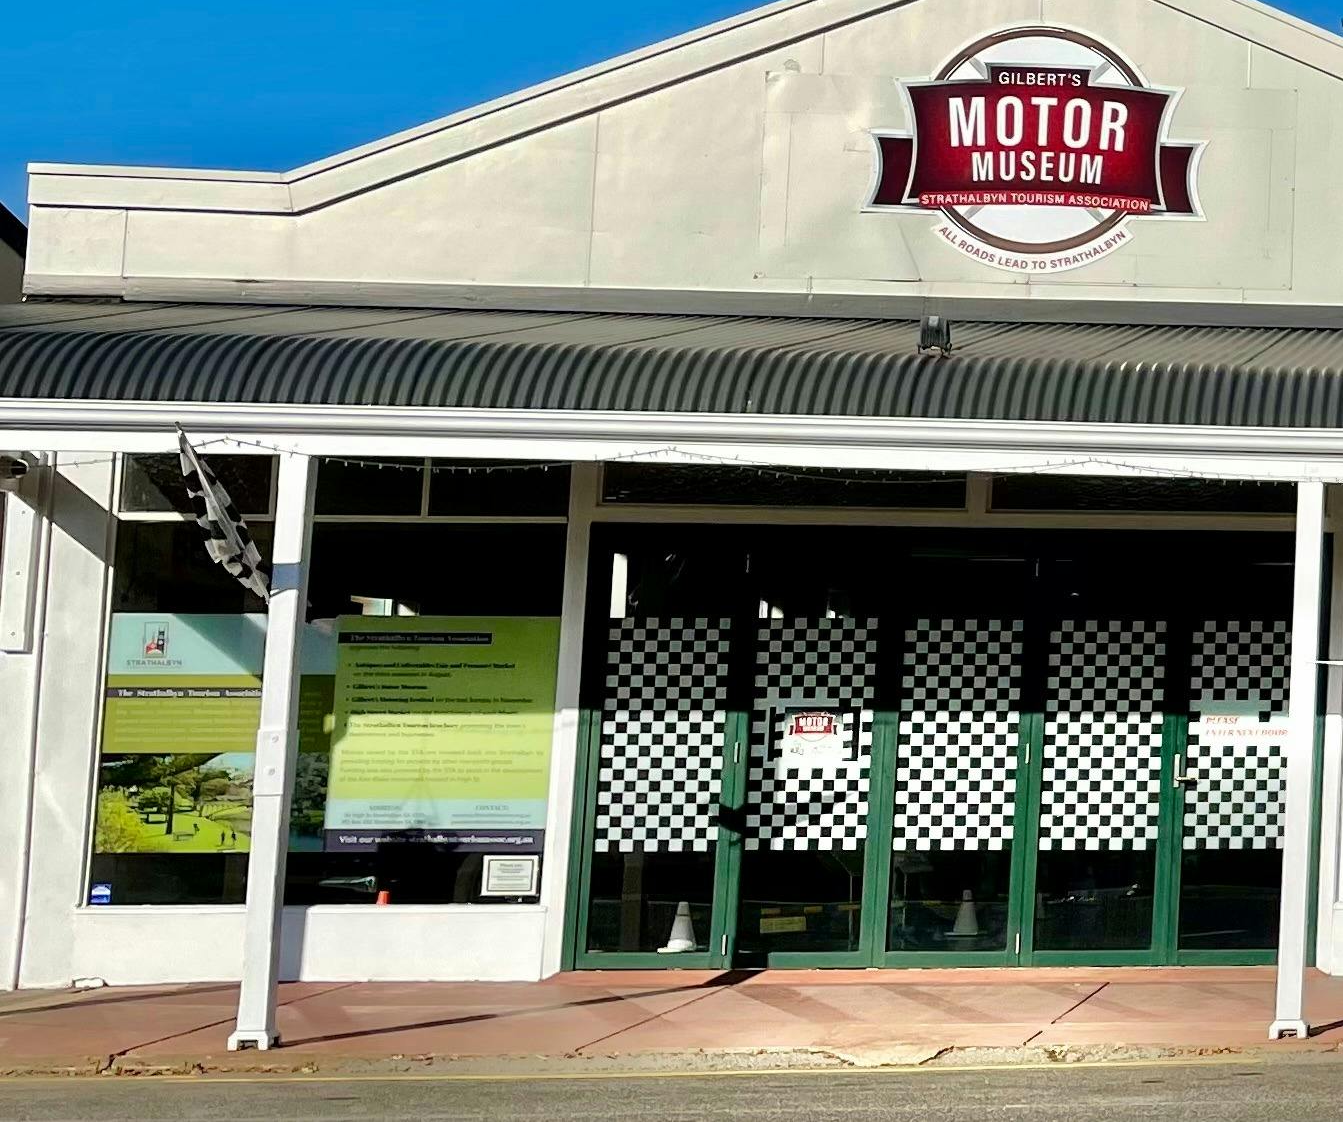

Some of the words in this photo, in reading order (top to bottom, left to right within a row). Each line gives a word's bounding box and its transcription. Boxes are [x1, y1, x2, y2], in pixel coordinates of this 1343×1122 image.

[998, 71, 1081, 87] GILBERT'S
[948, 95, 1129, 152] MOTOR
[971, 150, 1104, 185] MUSEUM
[921, 192, 1007, 206] STRATHALBYN
[1011, 192, 1065, 206] TOURISM
[1068, 193, 1150, 212] ASSOCIATION
[938, 225, 958, 249] ALL
[958, 240, 996, 264] ROADS
[997, 256, 1029, 271] LEAD
[1031, 259, 1048, 271] TO
[1050, 230, 1127, 270] STRATHALBYN
[798, 716, 829, 726] MOTOR
